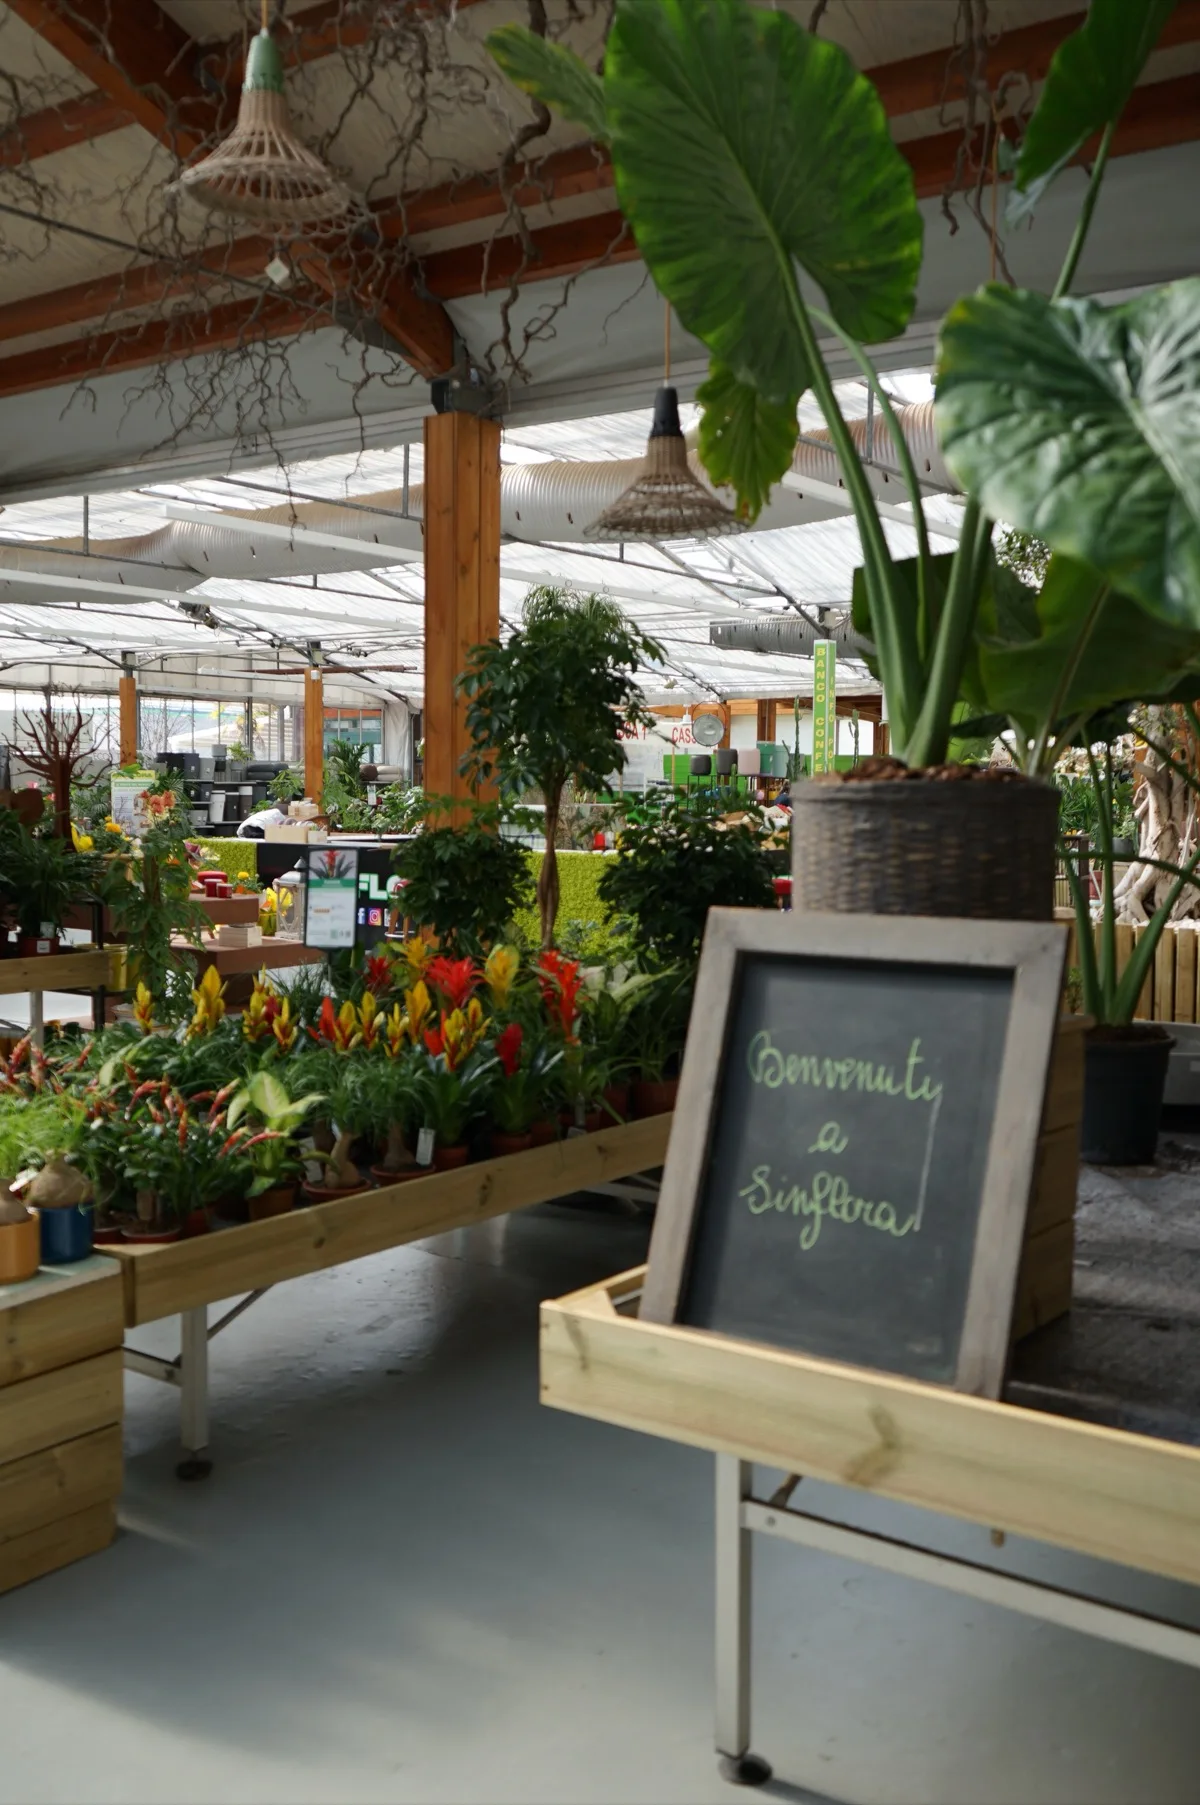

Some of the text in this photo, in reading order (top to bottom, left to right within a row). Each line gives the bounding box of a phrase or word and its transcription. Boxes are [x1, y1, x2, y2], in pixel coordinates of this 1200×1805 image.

[816, 647, 826, 703] BANCO
[748, 1030, 943, 1101] Benvenuti
[807, 1120, 848, 1154] a
